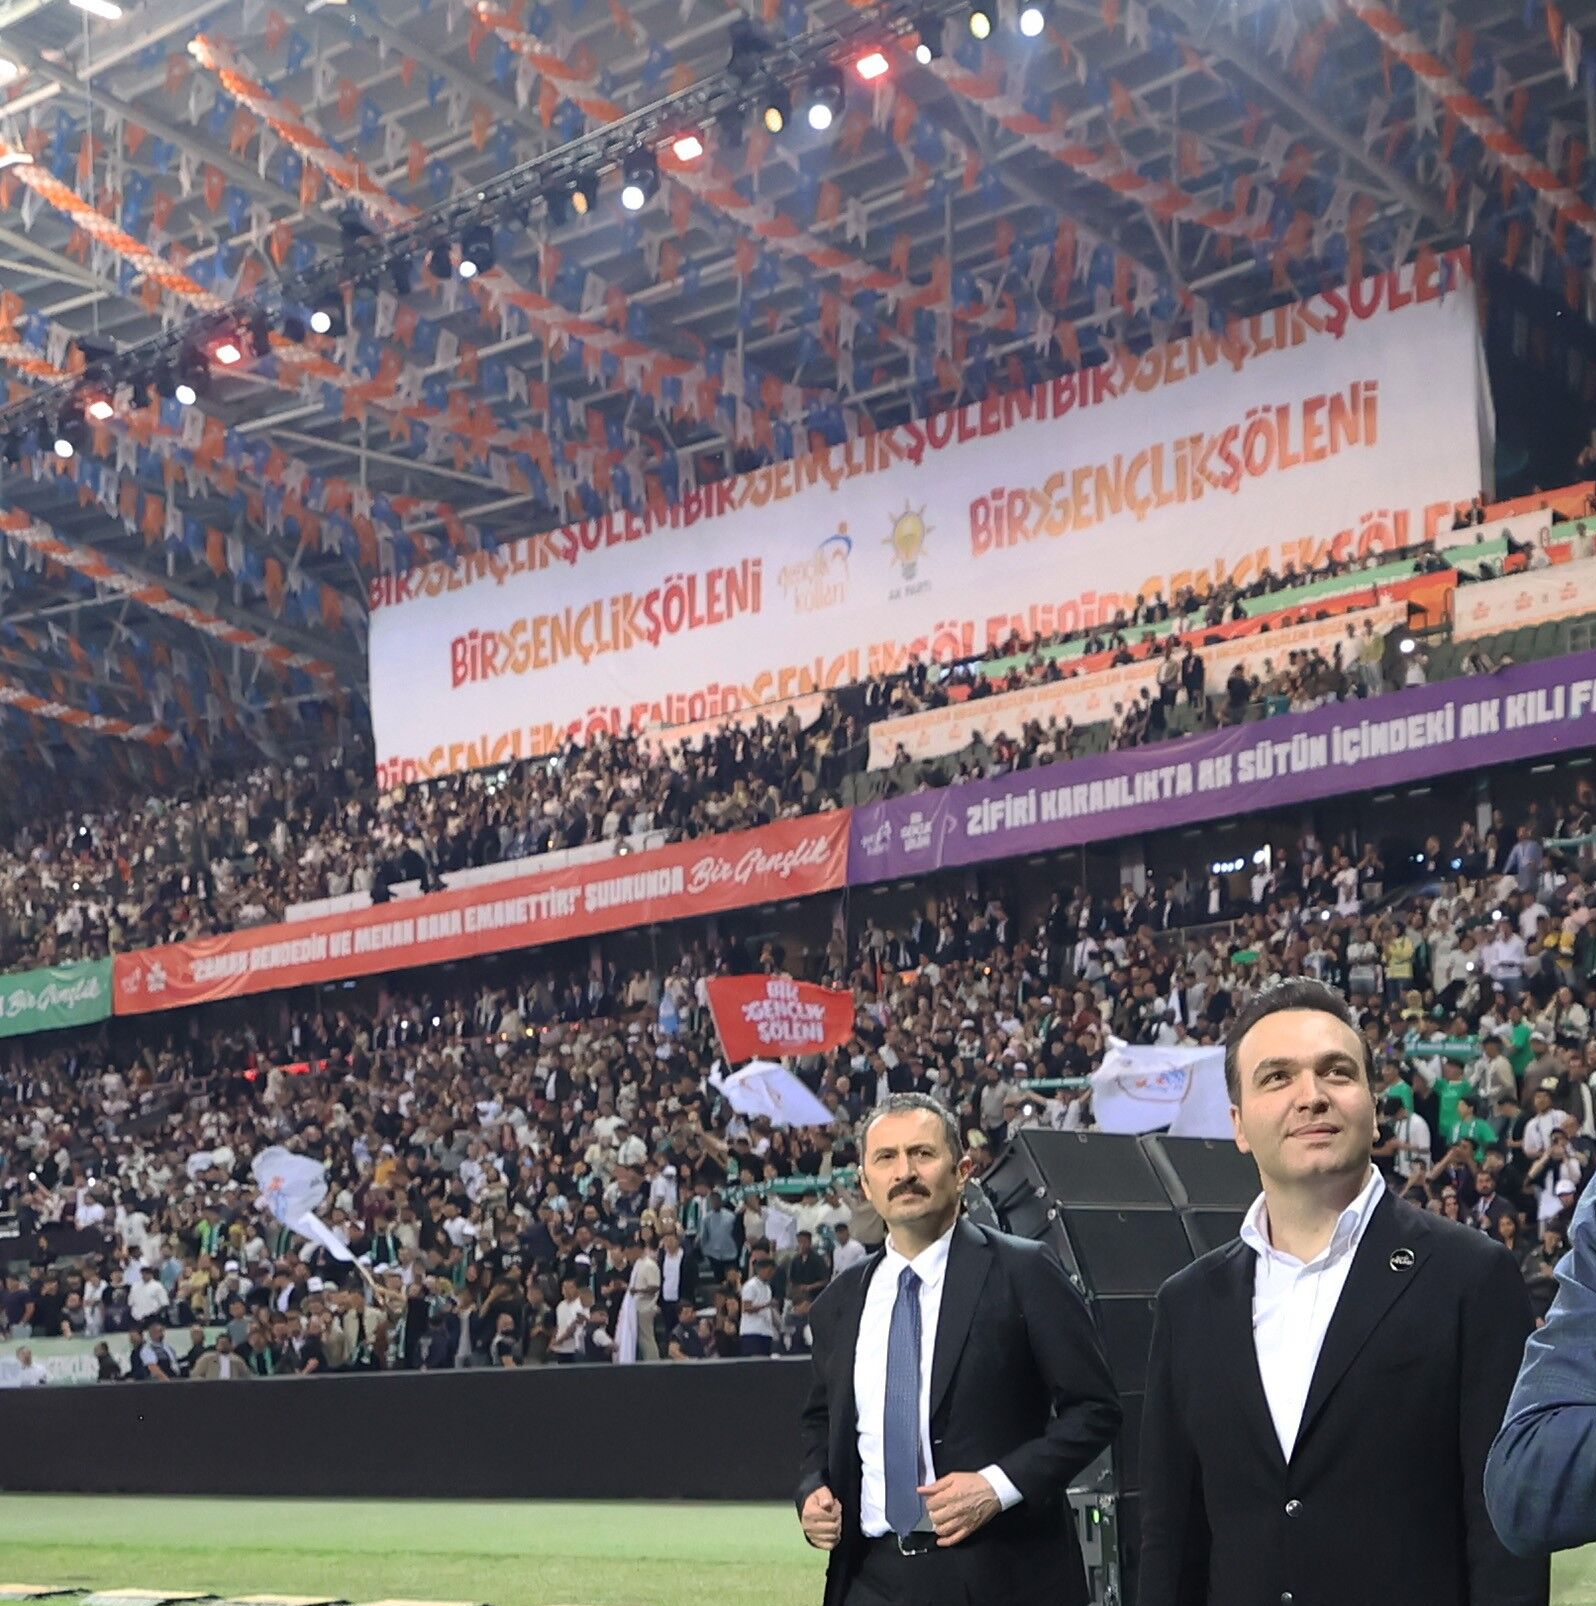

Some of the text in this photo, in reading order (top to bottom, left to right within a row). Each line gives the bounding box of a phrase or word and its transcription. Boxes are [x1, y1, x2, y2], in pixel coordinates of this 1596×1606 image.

[967, 787, 1036, 837] ZİFİRİ
[1041, 762, 1193, 822] KARANLIKTA
[1199, 757, 1232, 793] AK
[1237, 731, 1329, 785] SÜTÜN
[1332, 706, 1455, 767] İÇİNDEKİ
[1459, 698, 1501, 739] AK
[1506, 683, 1565, 730] KILI
[687, 856, 732, 894] Bir
[734, 836, 833, 887] Gençlik
